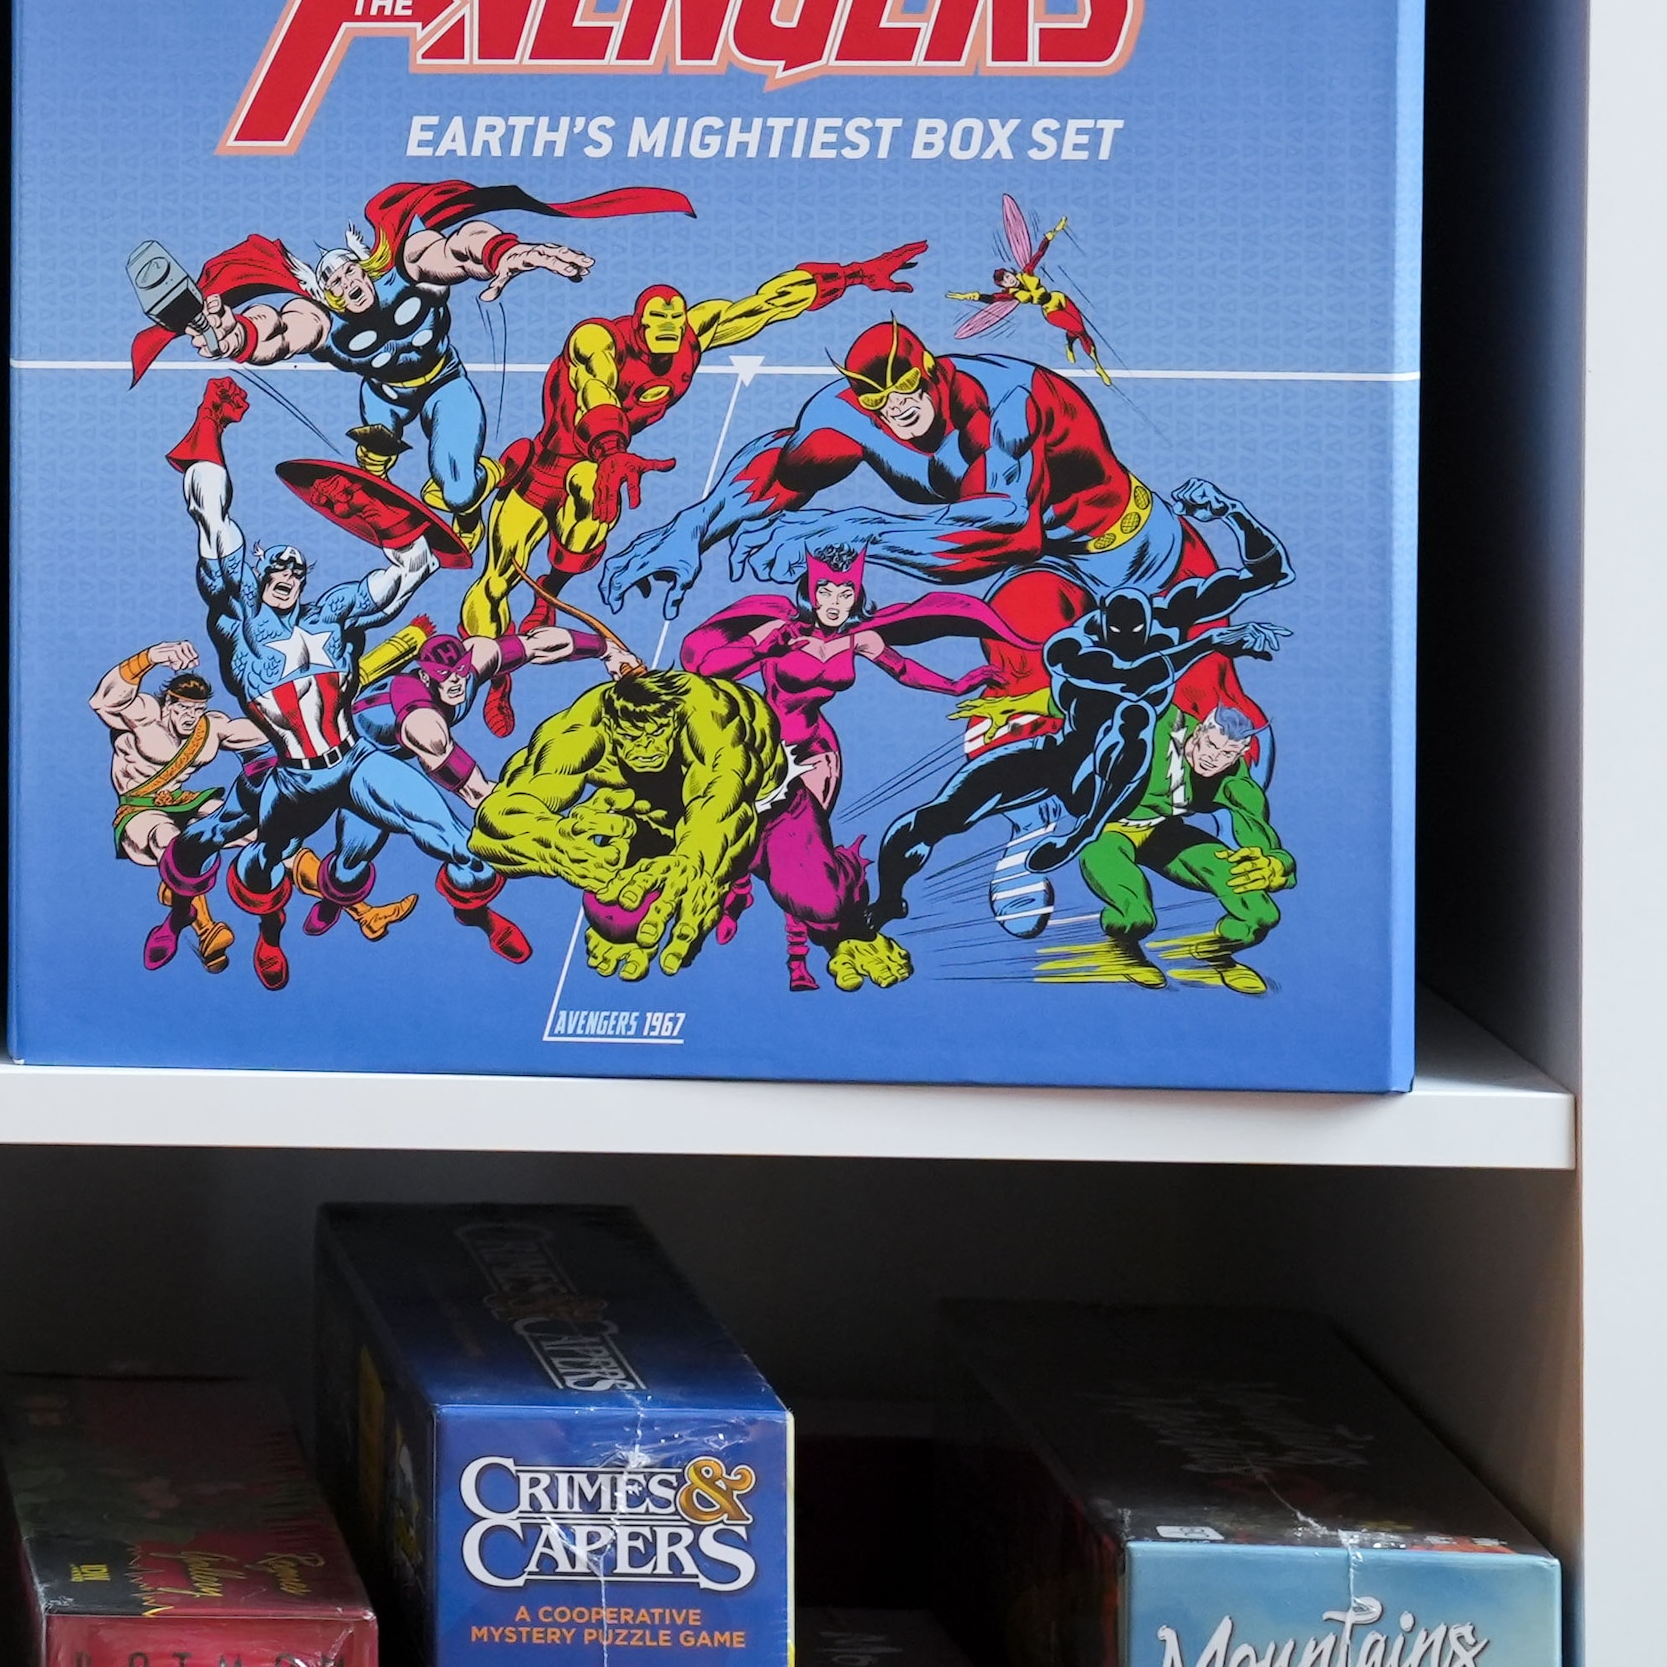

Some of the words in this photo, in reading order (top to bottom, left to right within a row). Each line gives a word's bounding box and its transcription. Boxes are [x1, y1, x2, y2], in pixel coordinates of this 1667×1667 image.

[406, 116, 615, 157] EARTH'S
[627, 117, 902, 159] MIGHTIEST
[911, 118, 1021, 159] BOX
[1027, 119, 1124, 160] SET
[555, 1010, 638, 1036] AVENGERS
[644, 1011, 685, 1036] 1967
[460, 1456, 677, 1519] CRIMES
[679, 1455, 755, 1522] &
[461, 1523, 756, 1589] CAPERS
[515, 1606, 530, 1621] A
[536, 1608, 702, 1625] COOPERATIVE
[471, 1627, 578, 1645] MYSTERY
[583, 1629, 671, 1646] PUZZLE
[680, 1630, 745, 1648] GAME
